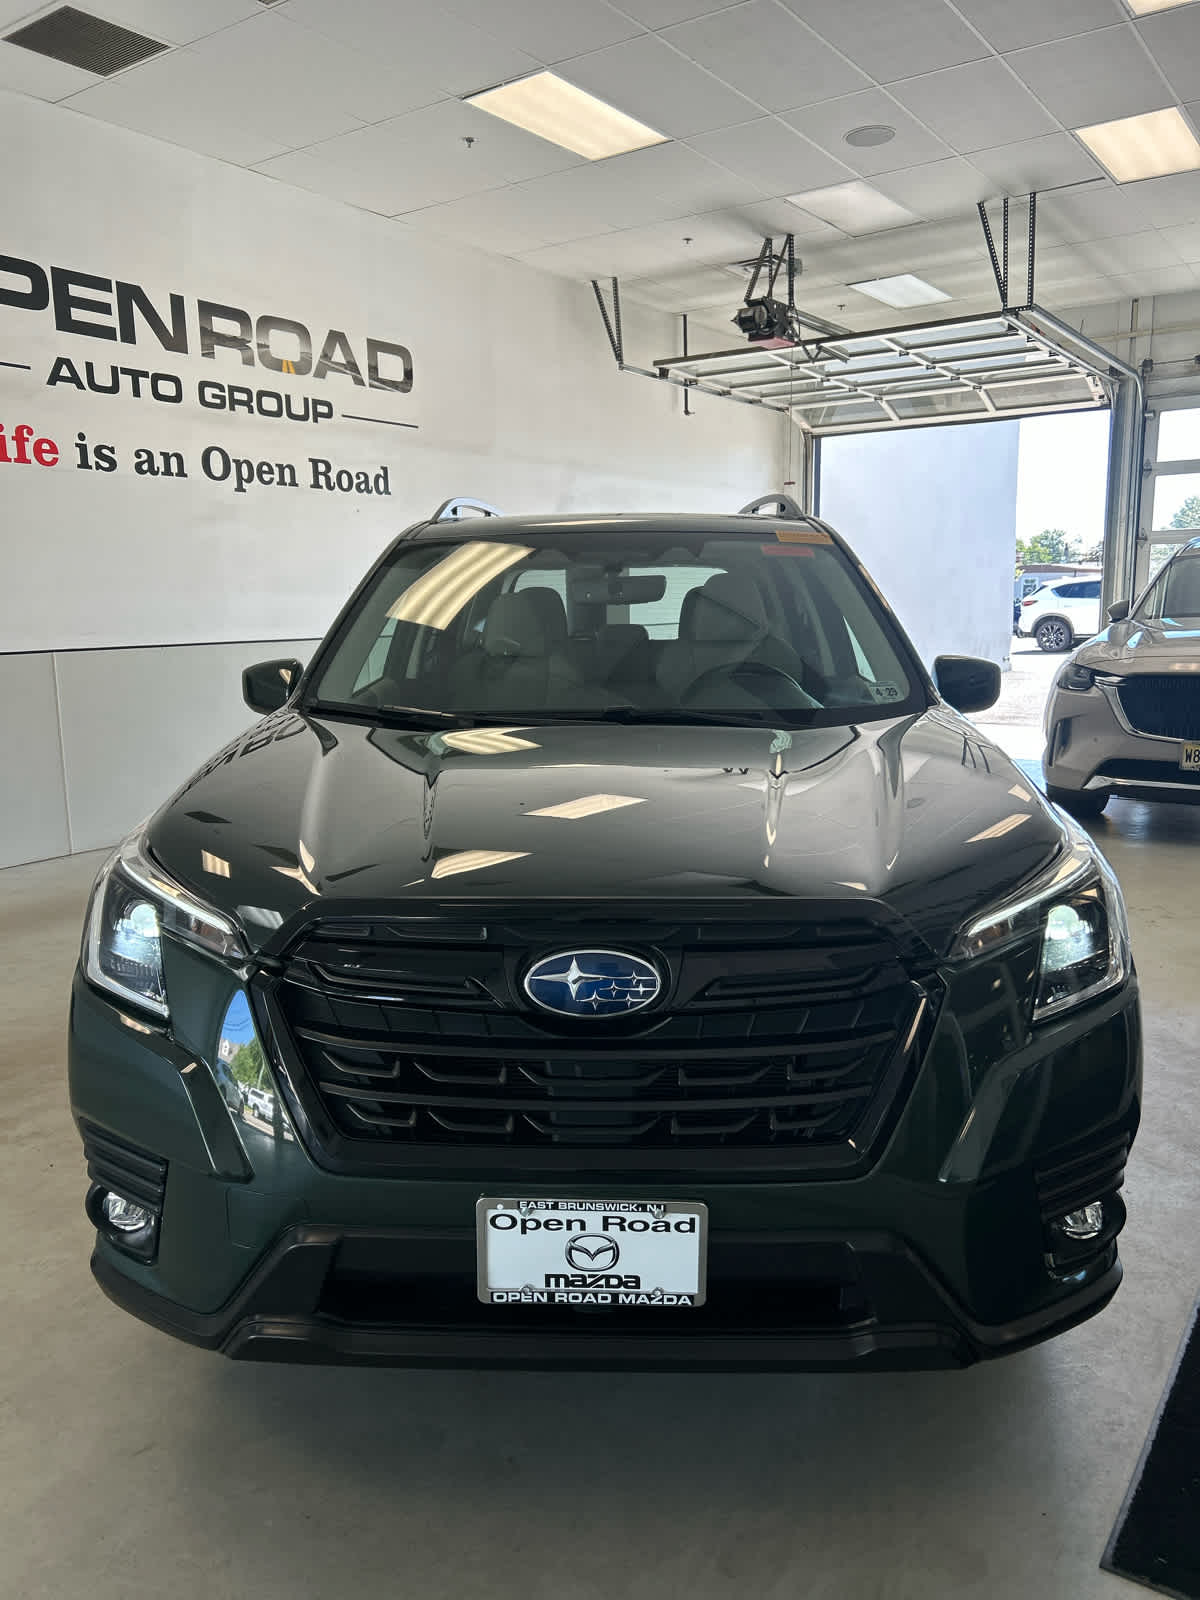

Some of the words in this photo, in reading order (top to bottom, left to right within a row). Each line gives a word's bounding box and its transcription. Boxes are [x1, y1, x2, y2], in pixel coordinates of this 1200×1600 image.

[46, 357, 183, 404] AUTO
[198, 381, 334, 424] GROUP
[75, 432, 118, 473] is
[135, 449, 188, 479] an
[201, 446, 299, 493] Open
[309, 458, 392, 496] Road
[519, 1201, 555, 1211] EAST
[489, 1213, 587, 1235] Open
[602, 1215, 696, 1234] Road
[544, 1273, 641, 1290] mazda
[492, 1291, 548, 1304] OPEN
[554, 1292, 612, 1304] ROAD
[618, 1293, 692, 1306] MAZDA
